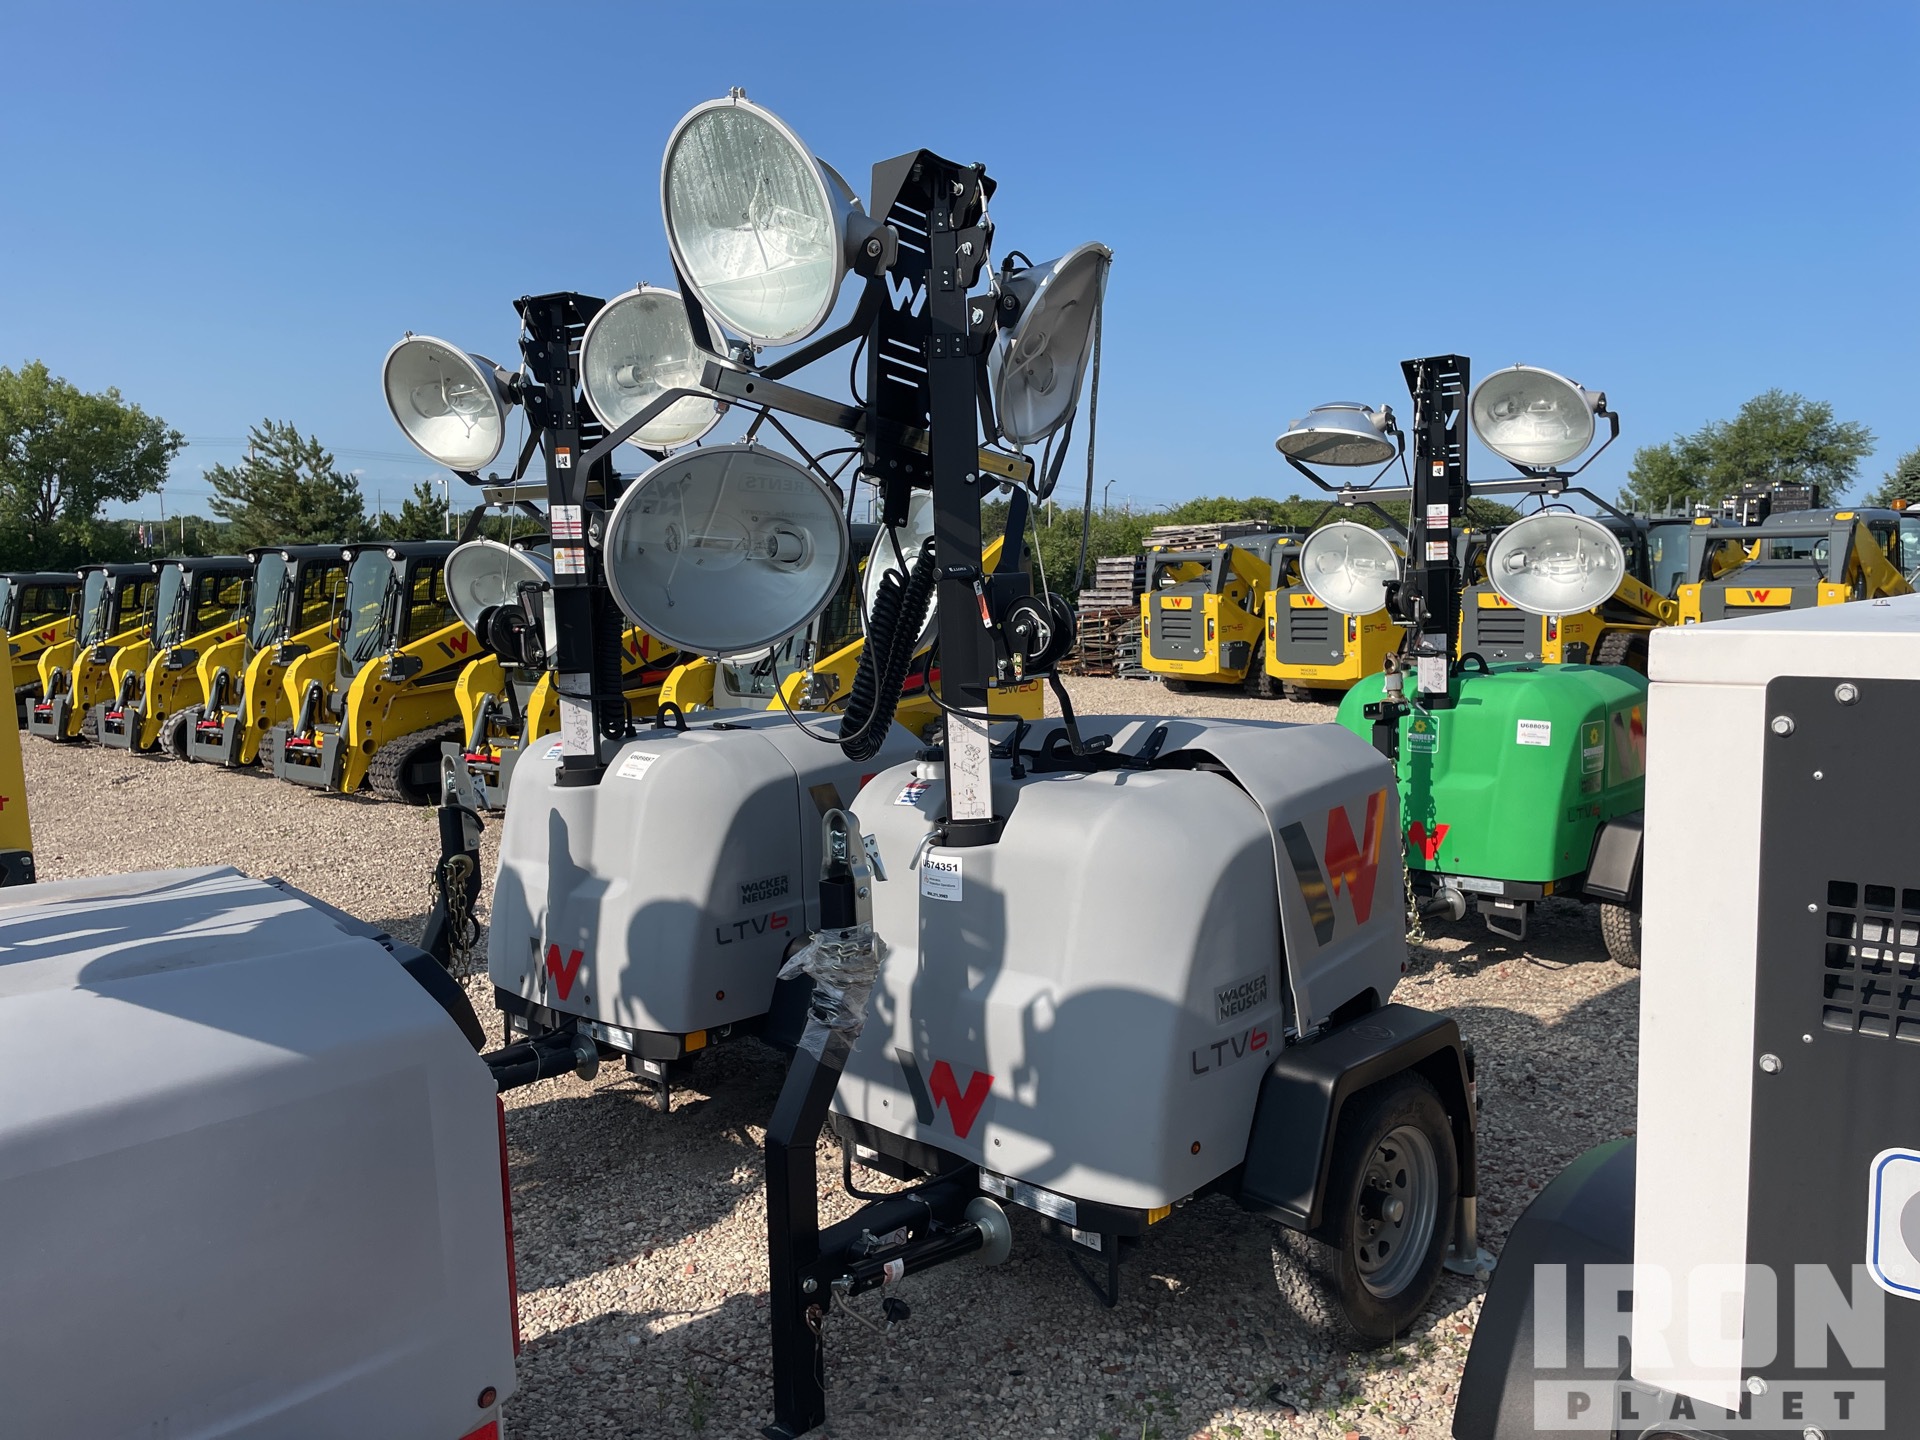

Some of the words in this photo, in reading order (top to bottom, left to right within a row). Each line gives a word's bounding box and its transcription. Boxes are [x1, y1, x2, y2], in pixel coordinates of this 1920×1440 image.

[1221, 623, 1244, 633] ST45
[1363, 623, 1387, 633] ST45
[1564, 623, 1584, 634] ST31
[922, 859, 958, 872] U674351
[741, 875, 789, 894] WACKER
[742, 884, 789, 904] NEUSON
[716, 912, 789, 945] LTV6
[1218, 974, 1267, 1004] WACKER
[1219, 987, 1268, 1020] NEUSON
[1192, 1027, 1268, 1075] LTV6
